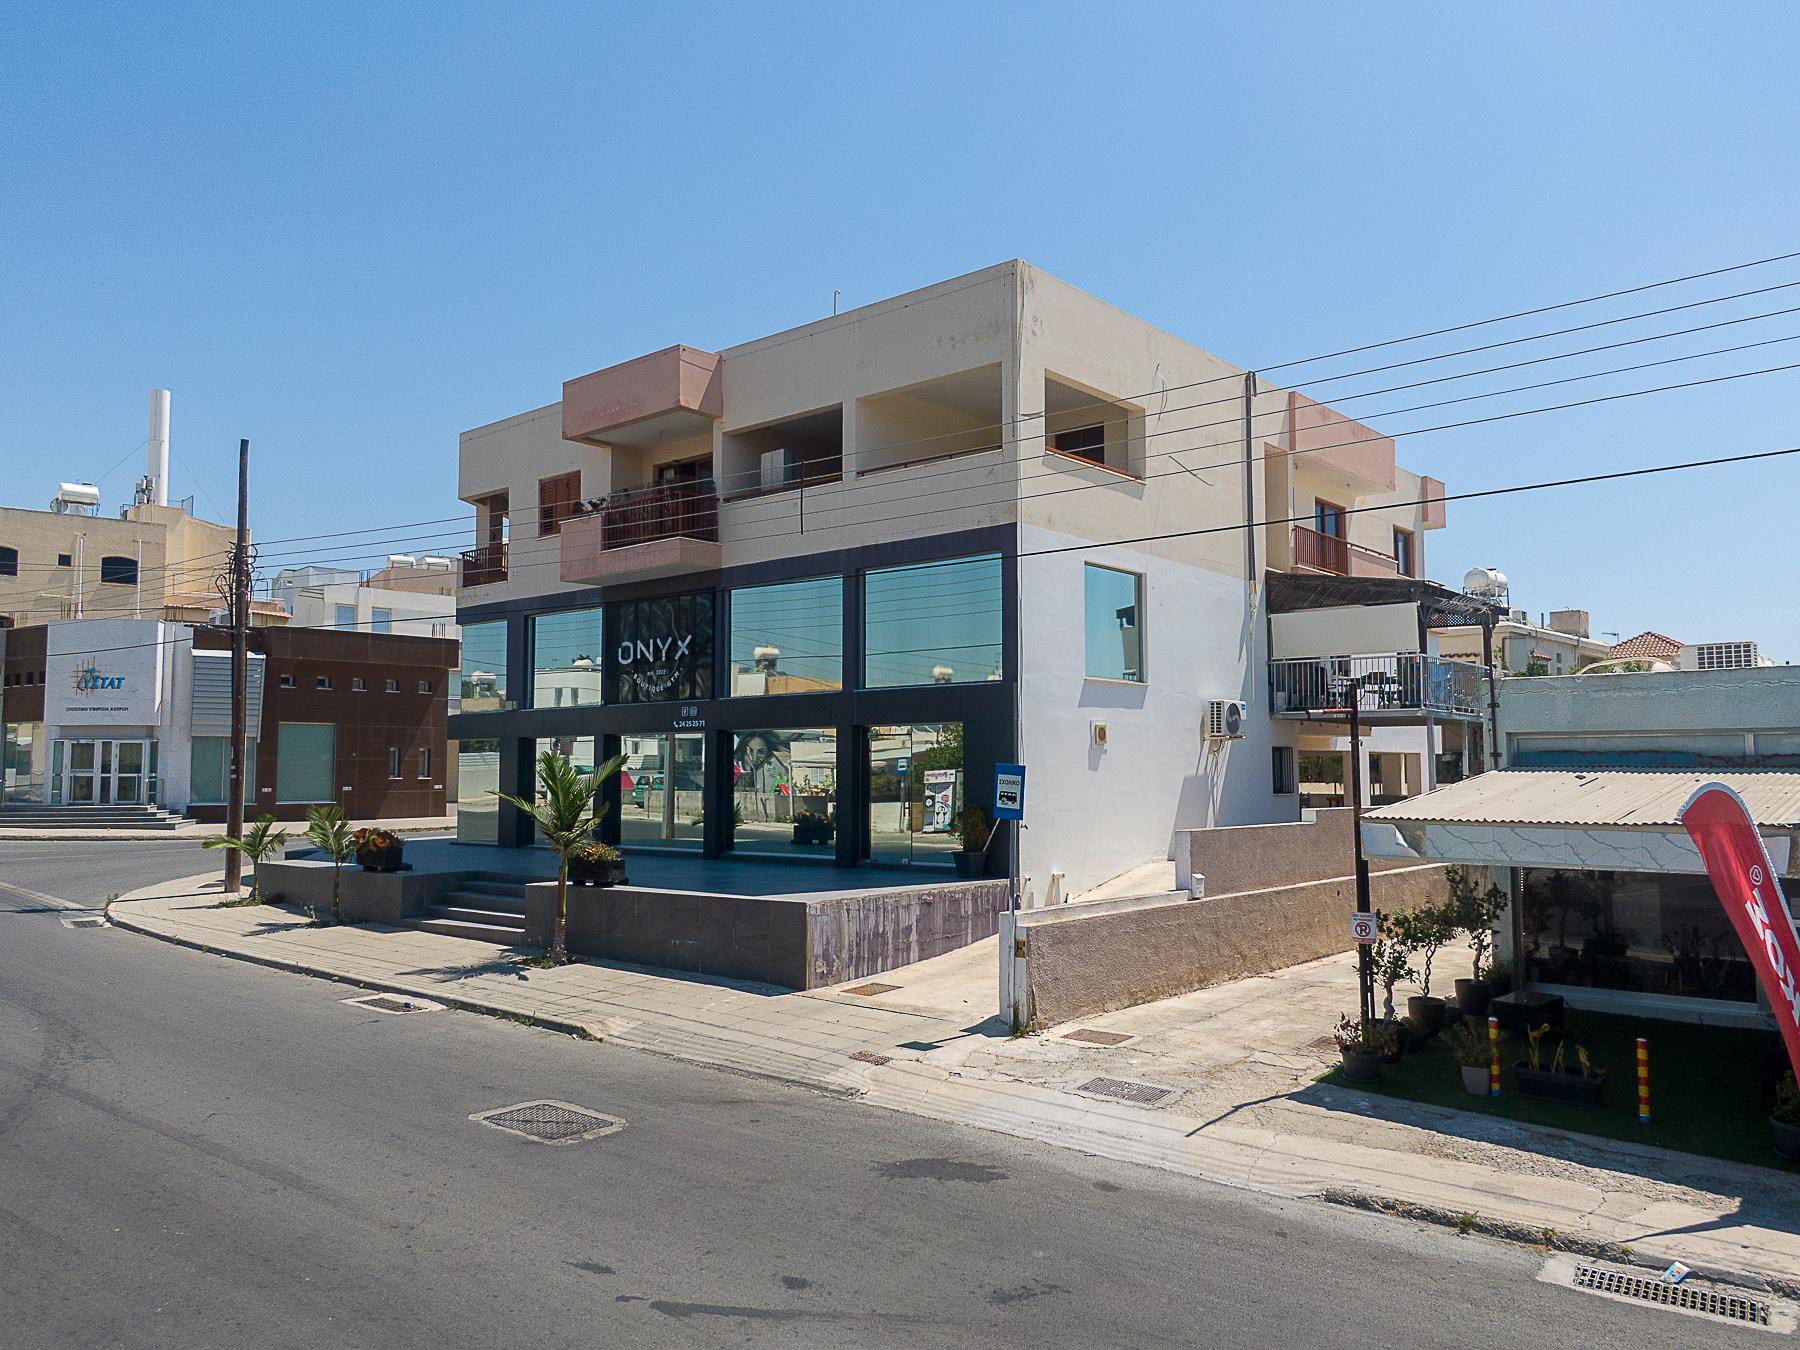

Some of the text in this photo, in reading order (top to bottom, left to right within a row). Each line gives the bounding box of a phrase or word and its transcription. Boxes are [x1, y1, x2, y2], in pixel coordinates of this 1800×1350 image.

[618, 634, 692, 664] ONYX
[633, 671, 680, 693] BOUTIQUE GYM
